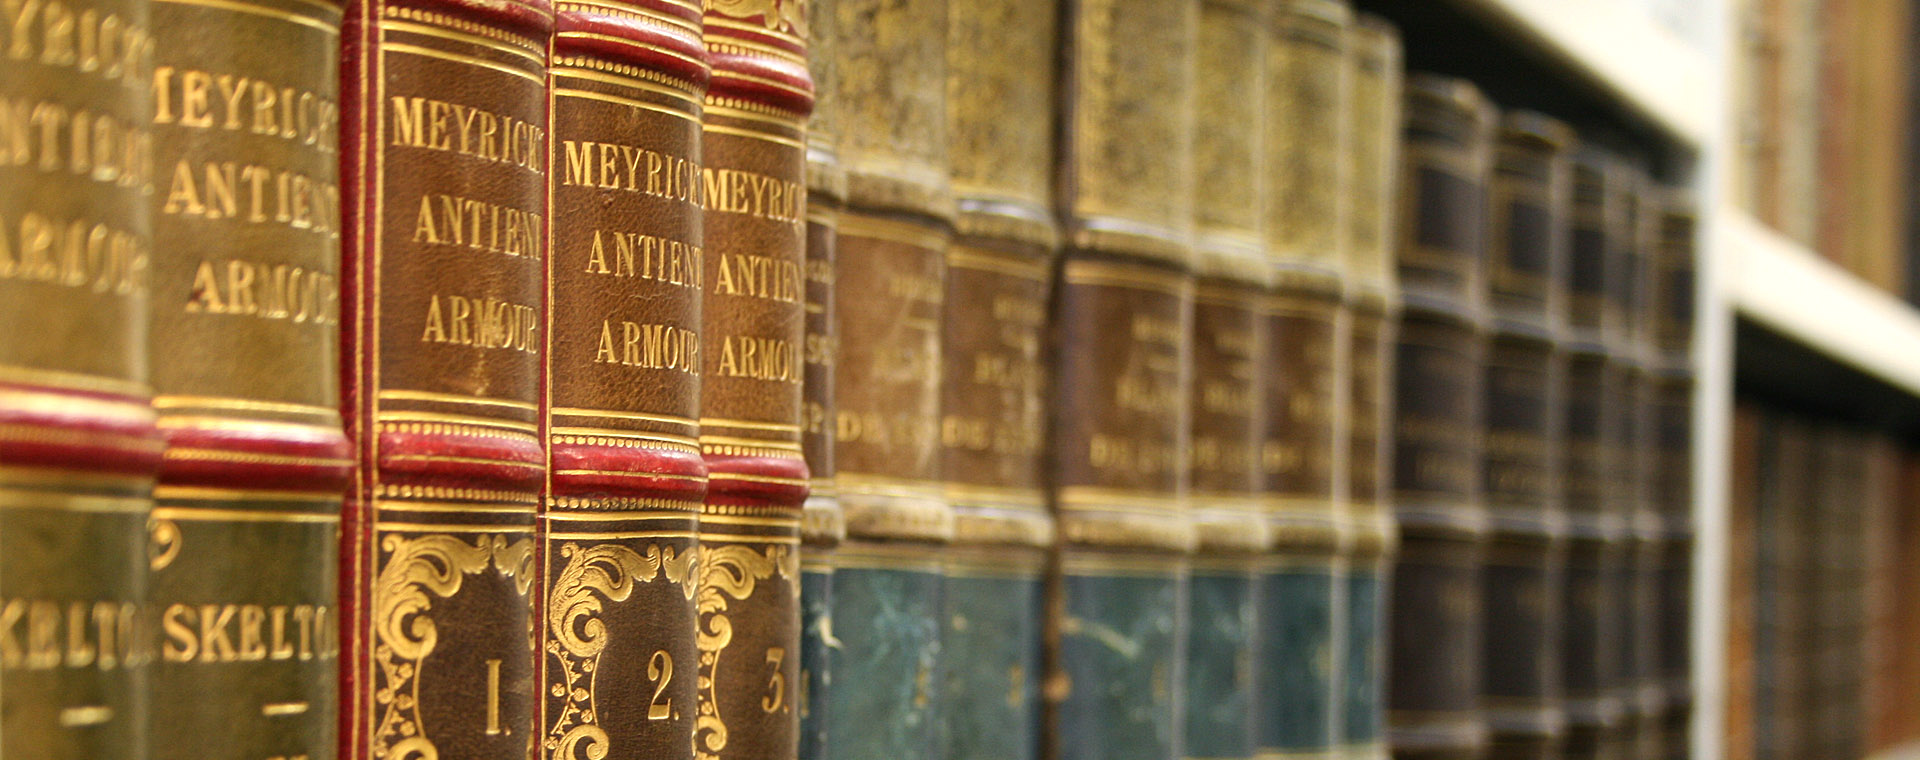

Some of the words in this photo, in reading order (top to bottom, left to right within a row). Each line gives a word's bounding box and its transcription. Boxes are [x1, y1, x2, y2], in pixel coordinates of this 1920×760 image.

[391, 96, 545, 176] MEYRICK
[422, 294, 538, 354] ARMOUR
[594, 319, 700, 376] ARMOUR
[647, 649, 680, 720] 2.
[761, 647, 790, 714] 3.
